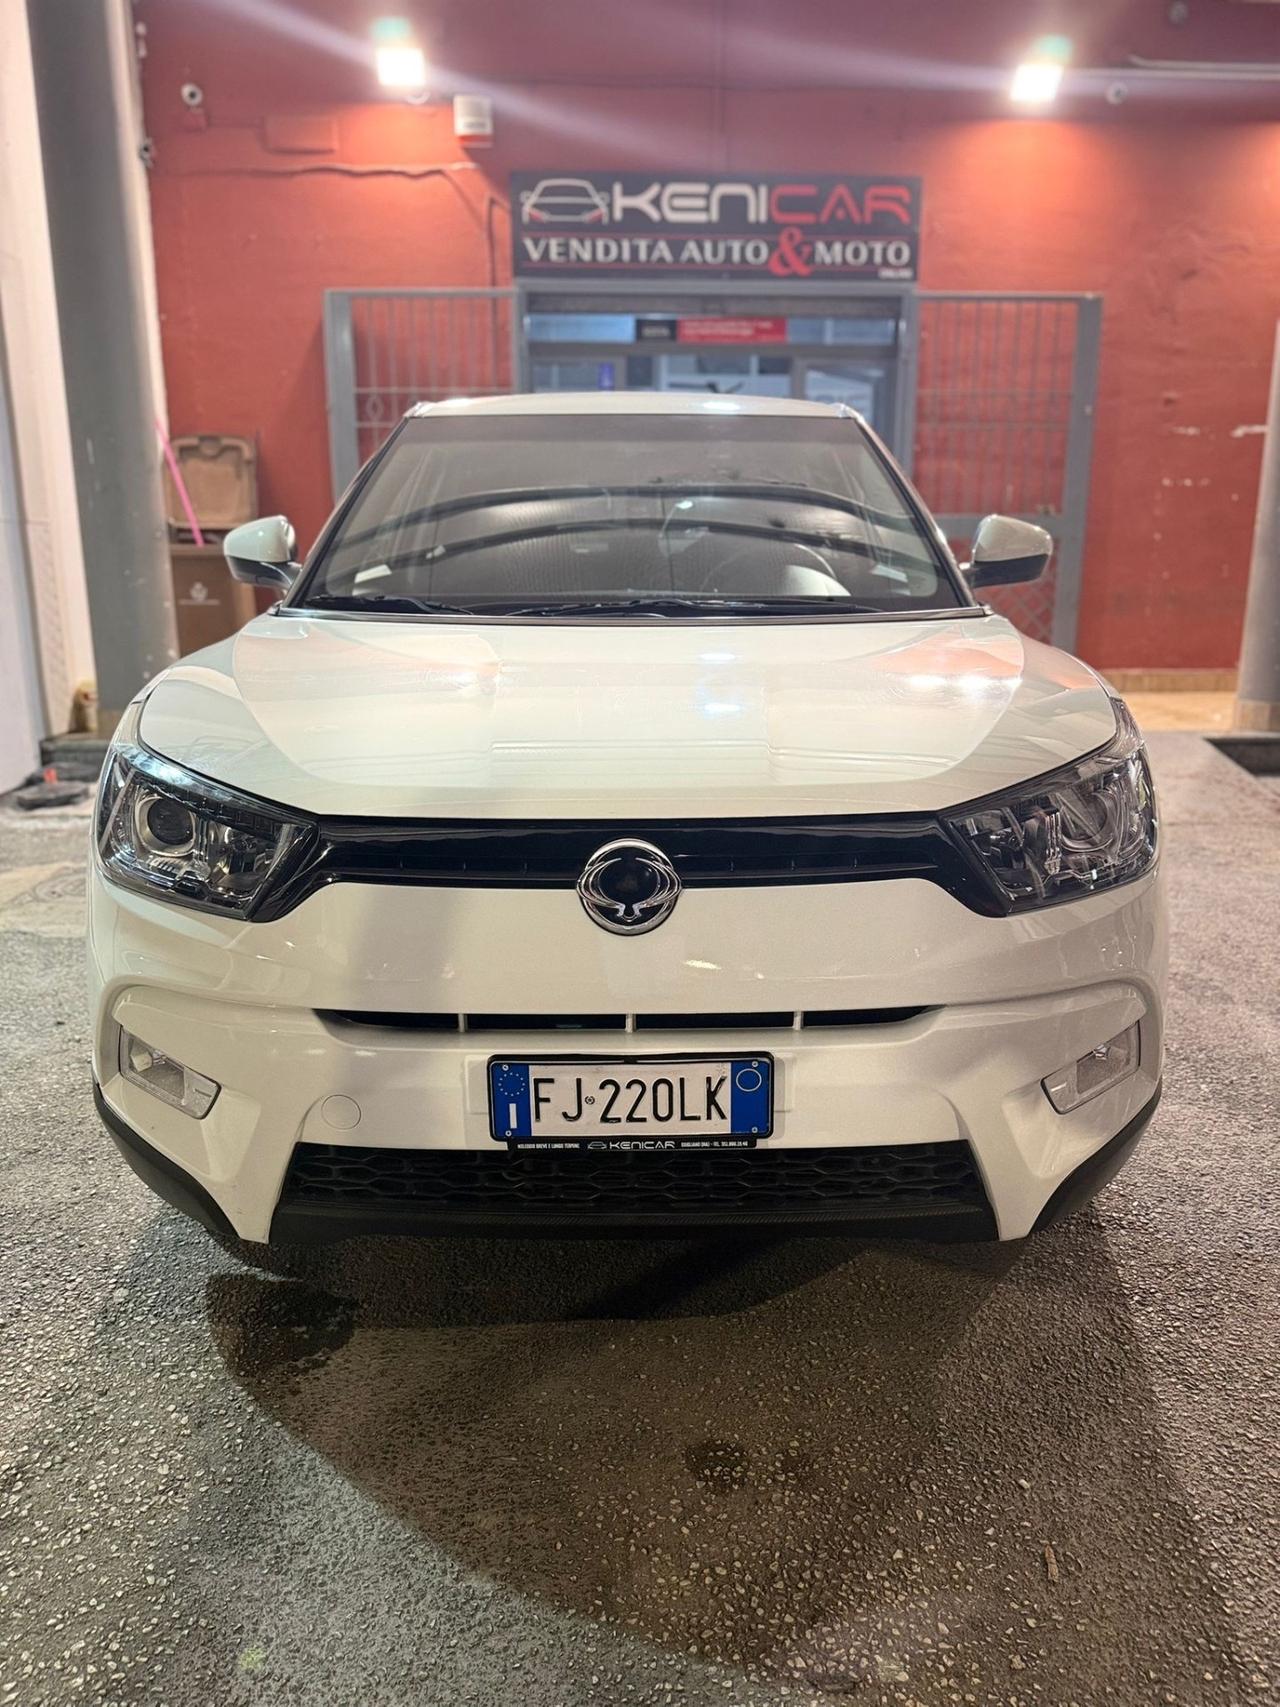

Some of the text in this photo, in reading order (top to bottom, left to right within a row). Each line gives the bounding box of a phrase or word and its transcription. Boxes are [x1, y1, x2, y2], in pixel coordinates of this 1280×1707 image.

[612, 182, 912, 225] KENICAR
[523, 237, 673, 264] VENDITA
[679, 238, 769, 265] AUTO
[814, 239, 910, 266] MOTO
[610, 1141, 675, 1149] KENICAR
